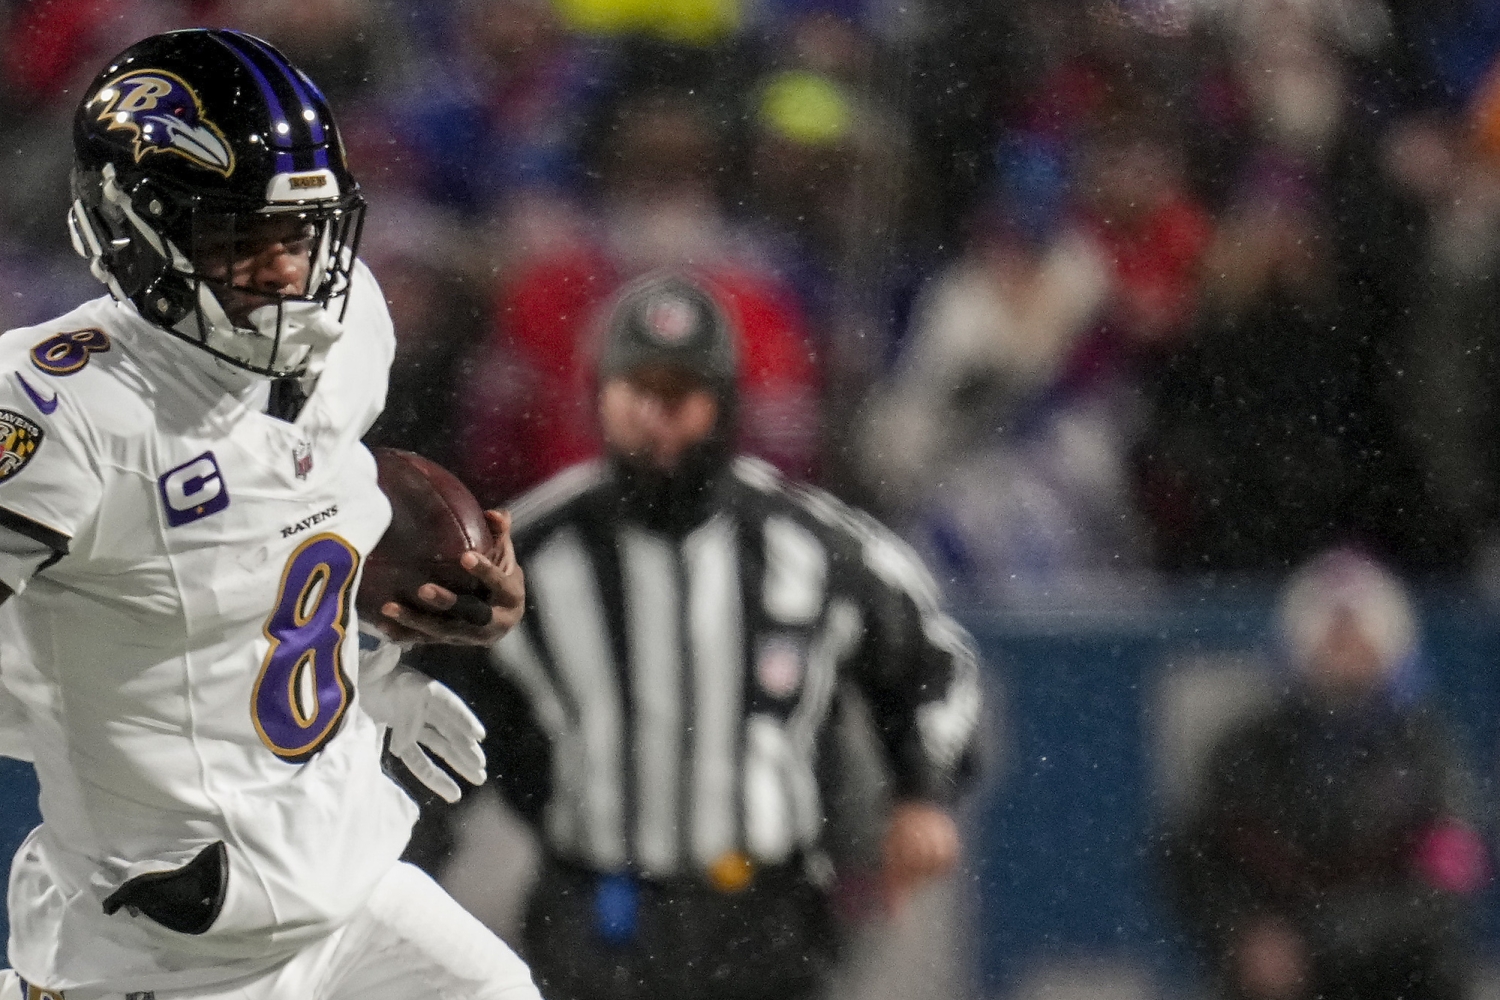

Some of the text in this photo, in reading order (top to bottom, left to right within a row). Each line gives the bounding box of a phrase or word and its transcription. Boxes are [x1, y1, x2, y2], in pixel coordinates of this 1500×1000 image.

[117, 76, 172, 112] B
[30, 326, 111, 377] 8
[164, 457, 222, 512] C
[280, 504, 339, 538] RAVENS
[249, 531, 361, 765] 8
